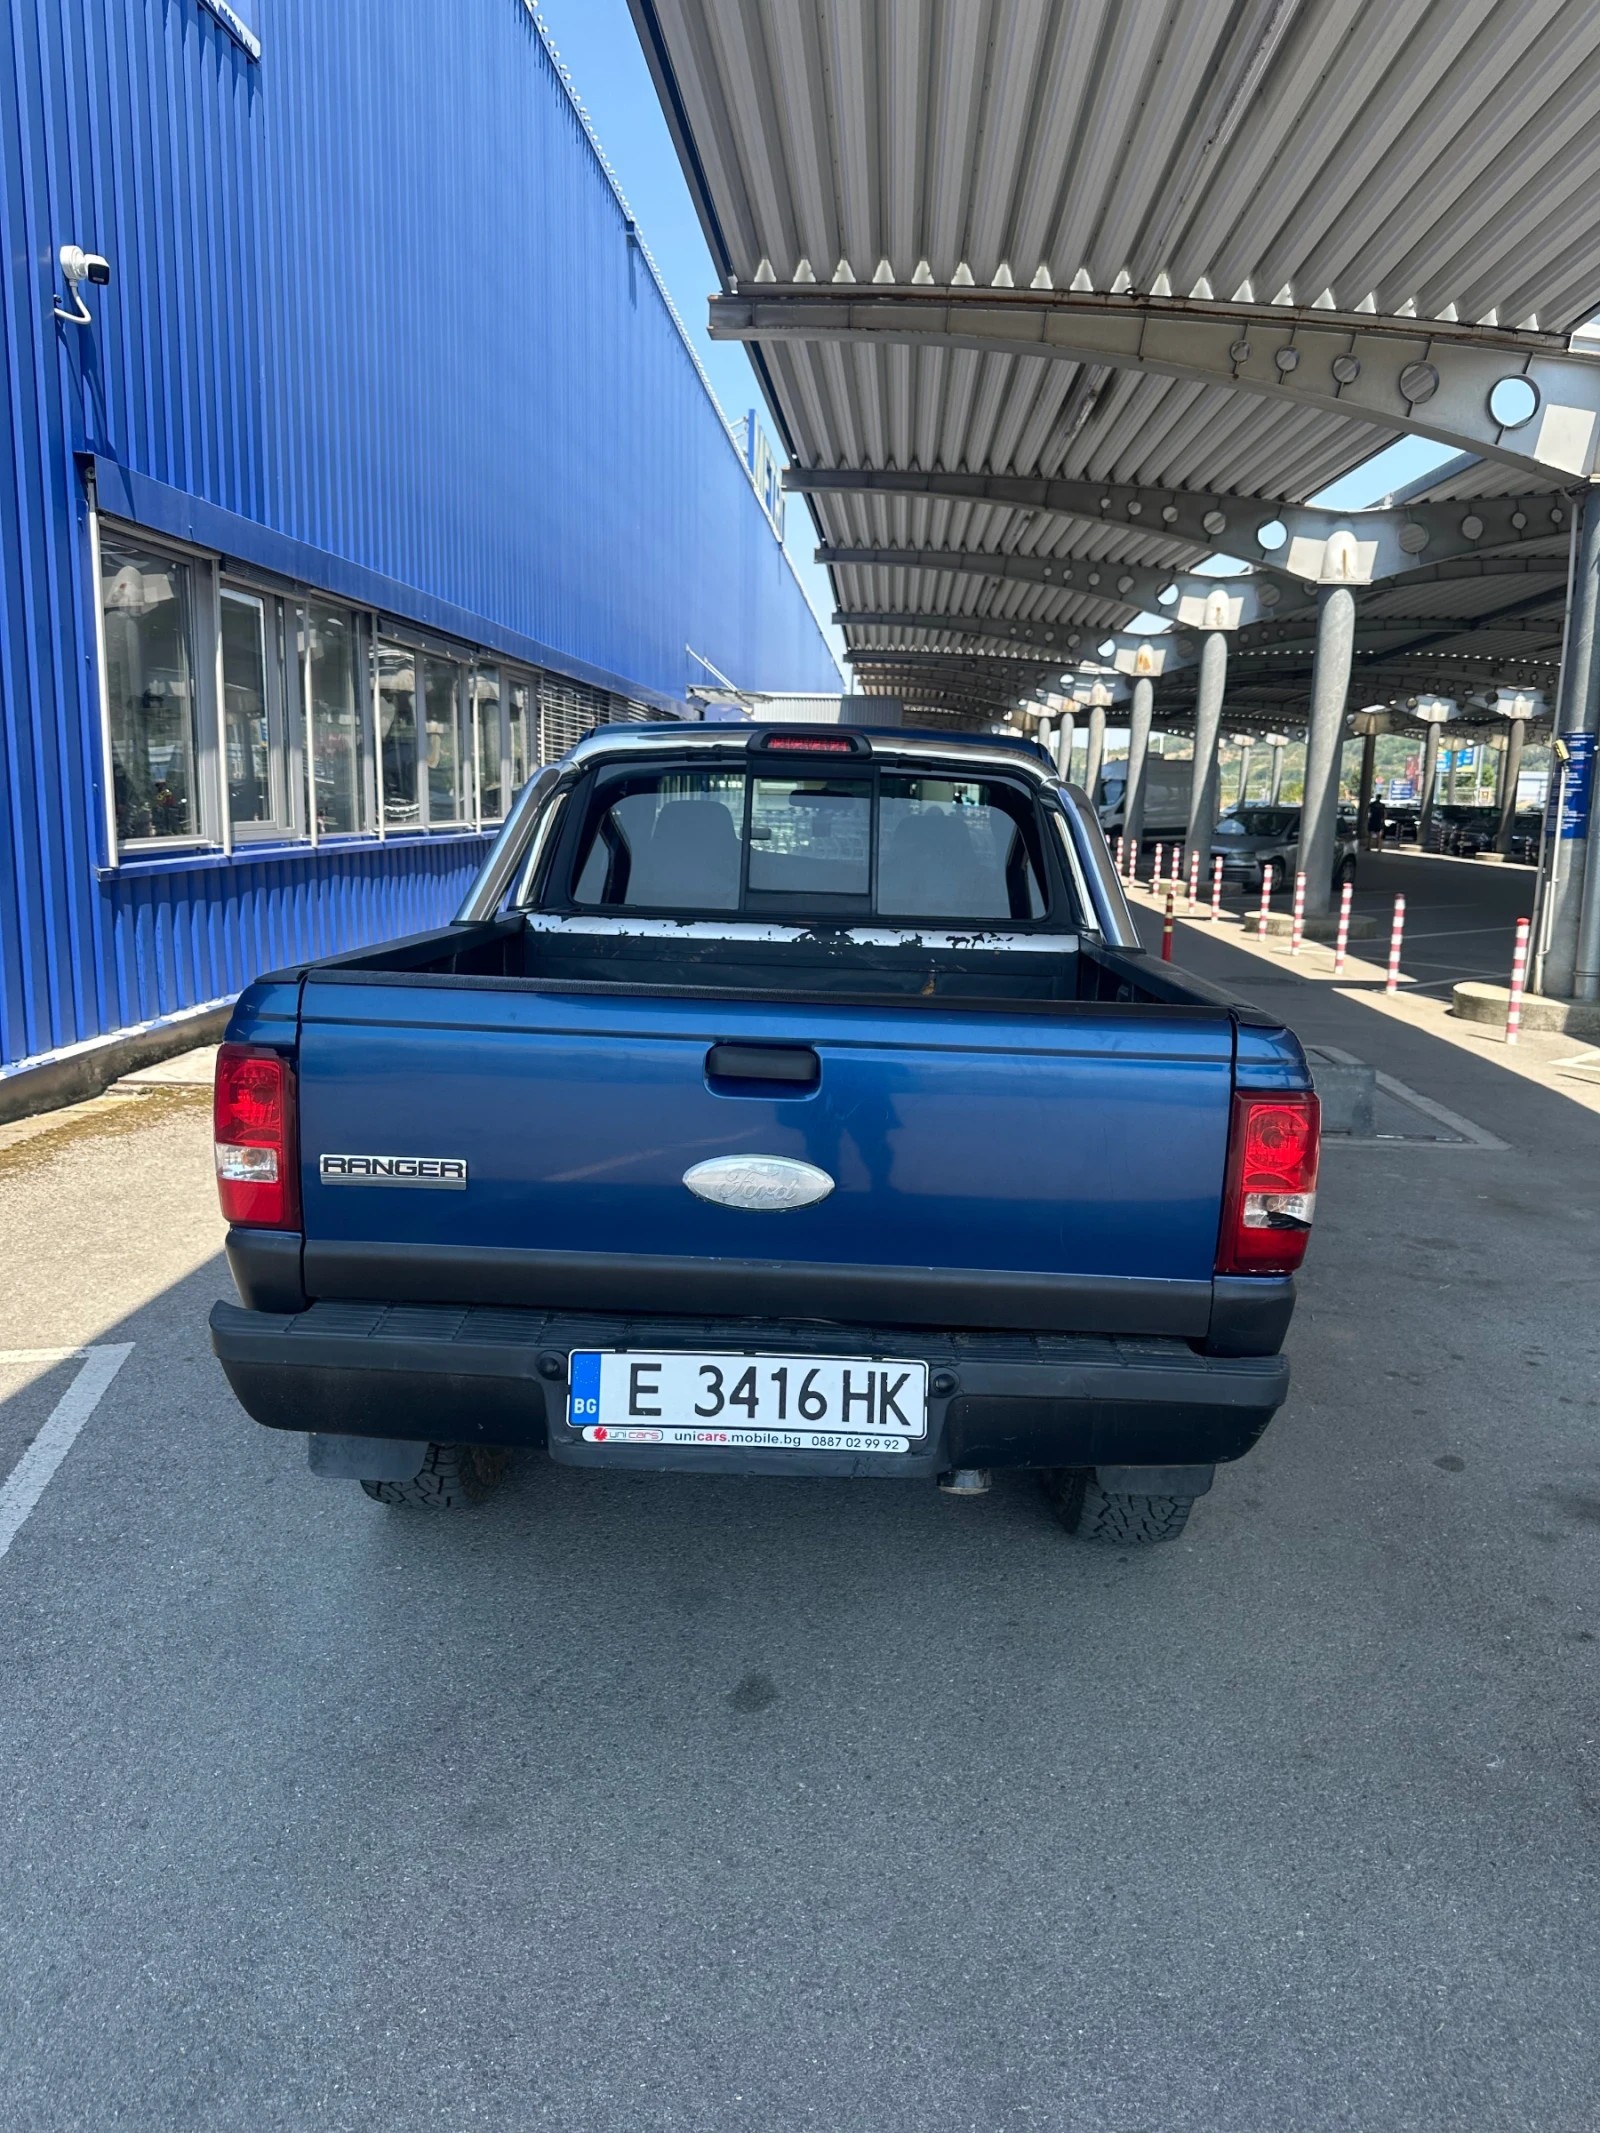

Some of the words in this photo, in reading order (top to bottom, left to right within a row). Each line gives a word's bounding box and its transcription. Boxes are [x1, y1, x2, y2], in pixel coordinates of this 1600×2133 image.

[323, 1156, 464, 1178] RANGER
[717, 1167, 799, 1202] Ford
[629, 1363, 662, 1416] E
[694, 1365, 828, 1421] 3416
[574, 1398, 597, 1414] BG
[674, 1431, 801, 1447] unicars.mobile.bg
[811, 1435, 842, 1447] 0887
[845, 1436, 862, 1448] 02
[865, 1437, 881, 1450] 99
[884, 1439, 899, 1451] 92
